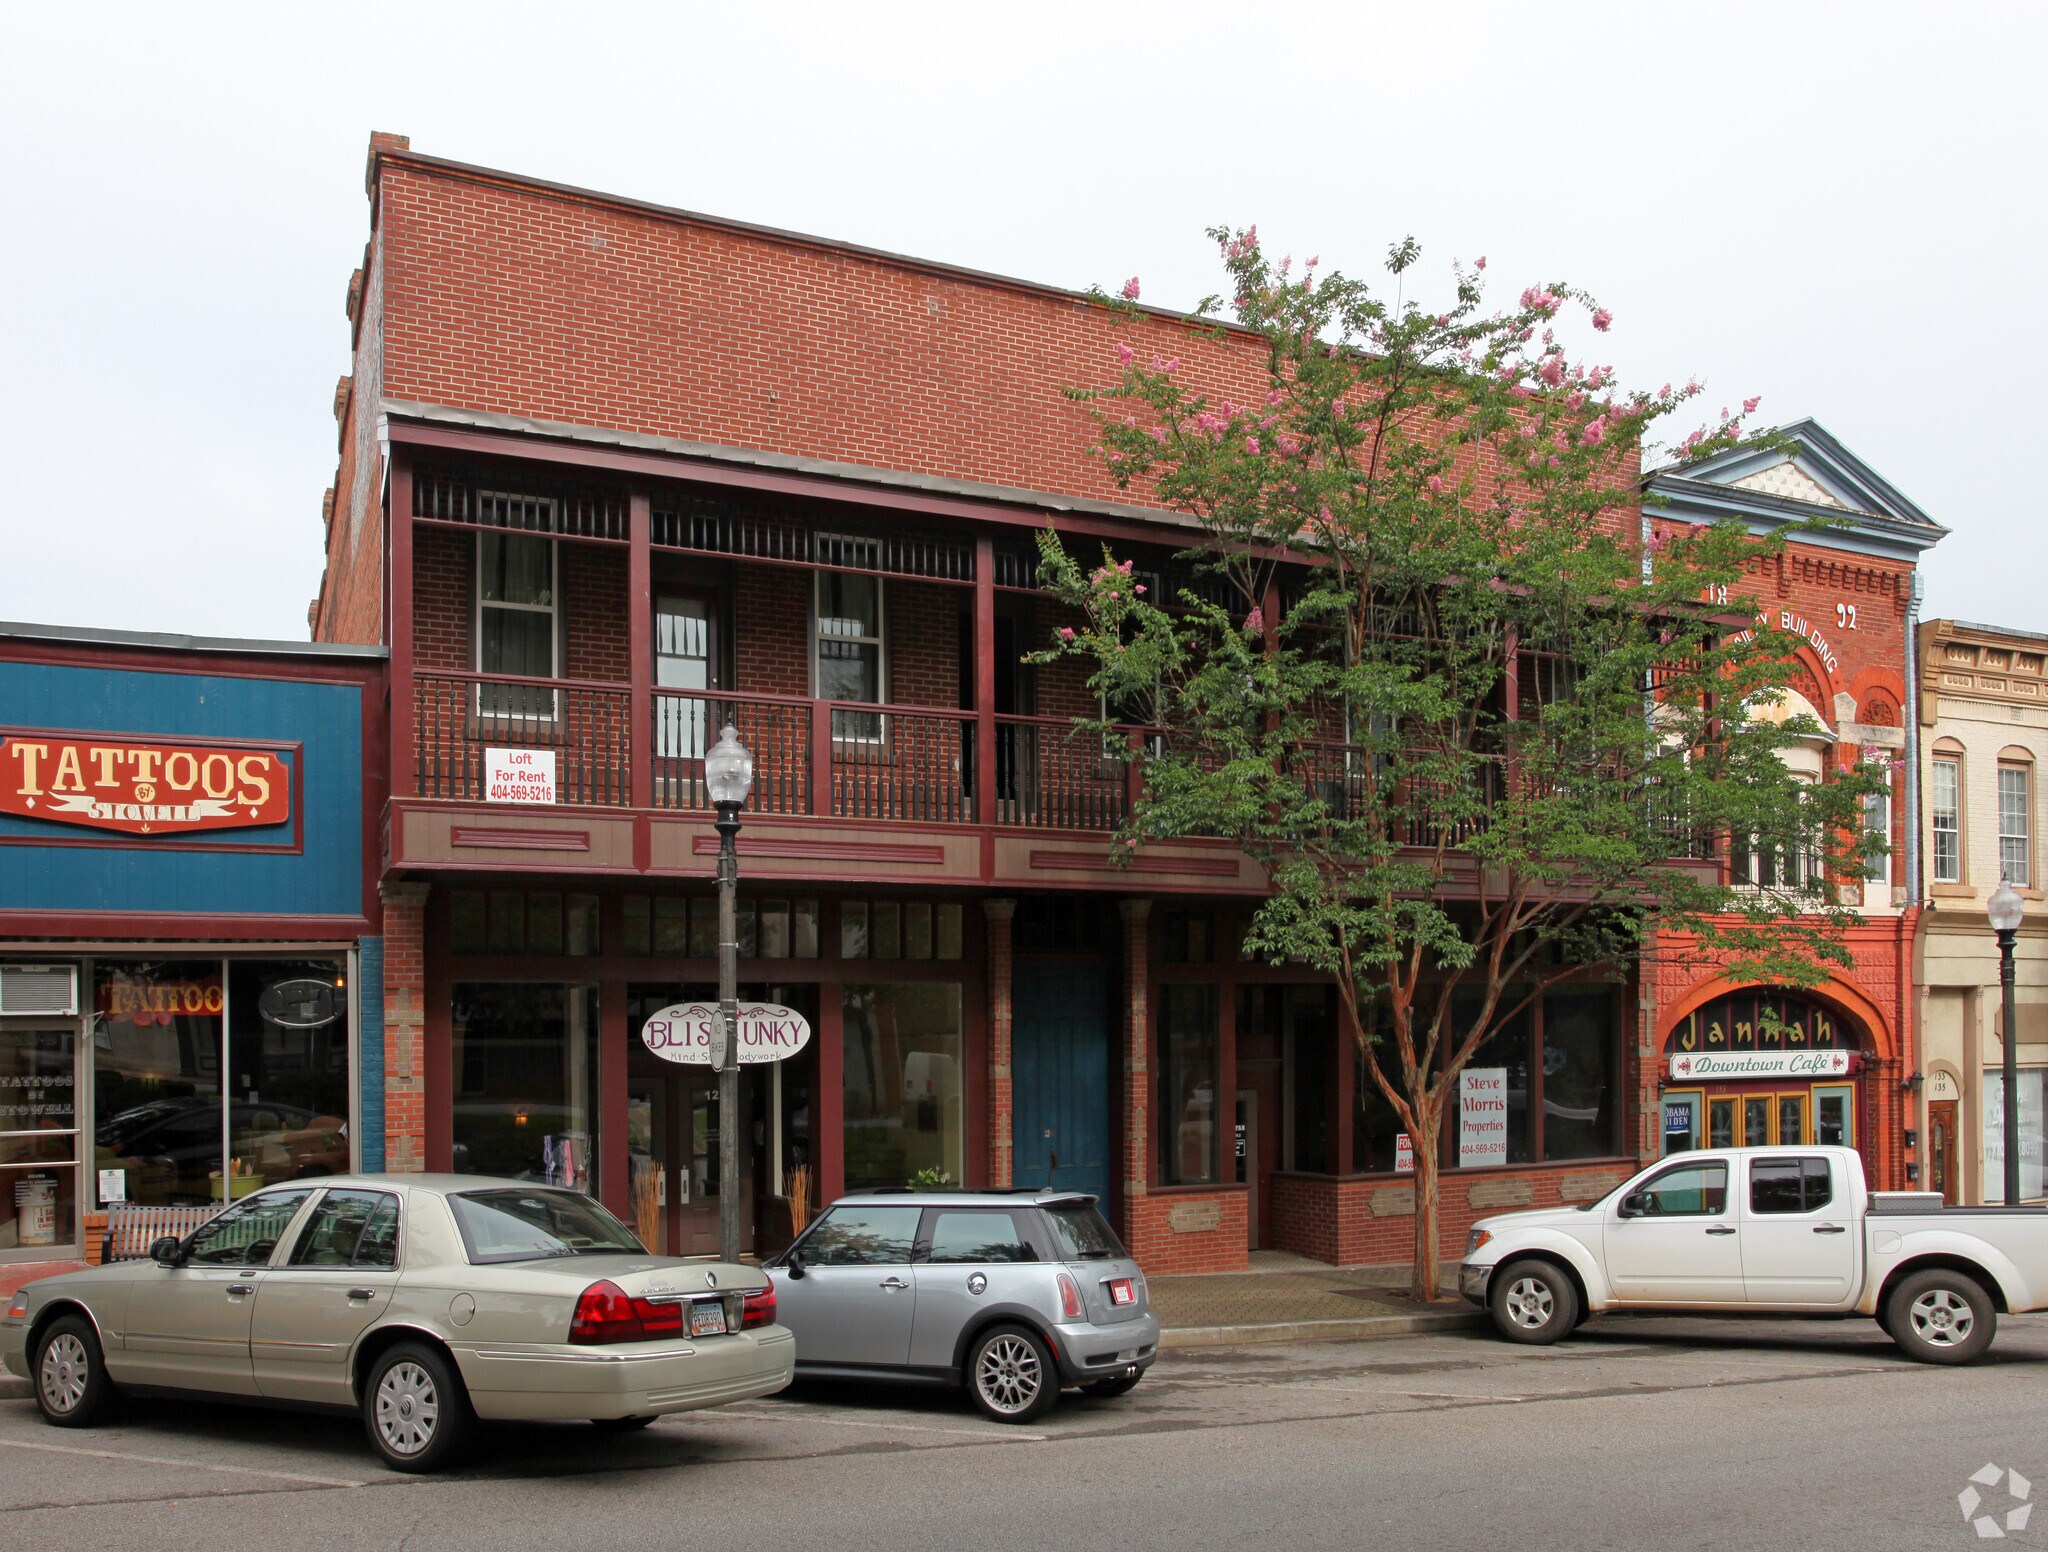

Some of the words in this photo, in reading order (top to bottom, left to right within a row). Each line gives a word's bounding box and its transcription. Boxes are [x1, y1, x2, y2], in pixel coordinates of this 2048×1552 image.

[1837, 603, 1857, 630] 92
[1781, 611, 1838, 674] BUILDING
[509, 753, 532, 764] Loft
[12, 743, 270, 805] TATTOOS
[495, 769, 515, 781] For
[518, 770, 546, 783] Rent
[138, 786, 151, 799] BY
[490, 784, 552, 801] 404-569-5216
[88, 800, 201, 821] STOWELL
[101, 983, 223, 1014] TATTOO
[740, 1052, 782, 1062] odywork
[1694, 1056, 1784, 1073] Downtown
[1789, 1053, 1830, 1073] Café
[0, 1075, 74, 1087] TATTOOS
[1467, 1077, 1500, 1091] Steve
[27, 1090, 45, 1099] BY
[705, 1090, 720, 1101] 12
[0, 1103, 74, 1116] STOWELL
[1462, 1096, 1505, 1113] Morris
[1463, 1119, 1504, 1136] Properties
[1461, 1143, 1505, 1154] 404-569-5216
